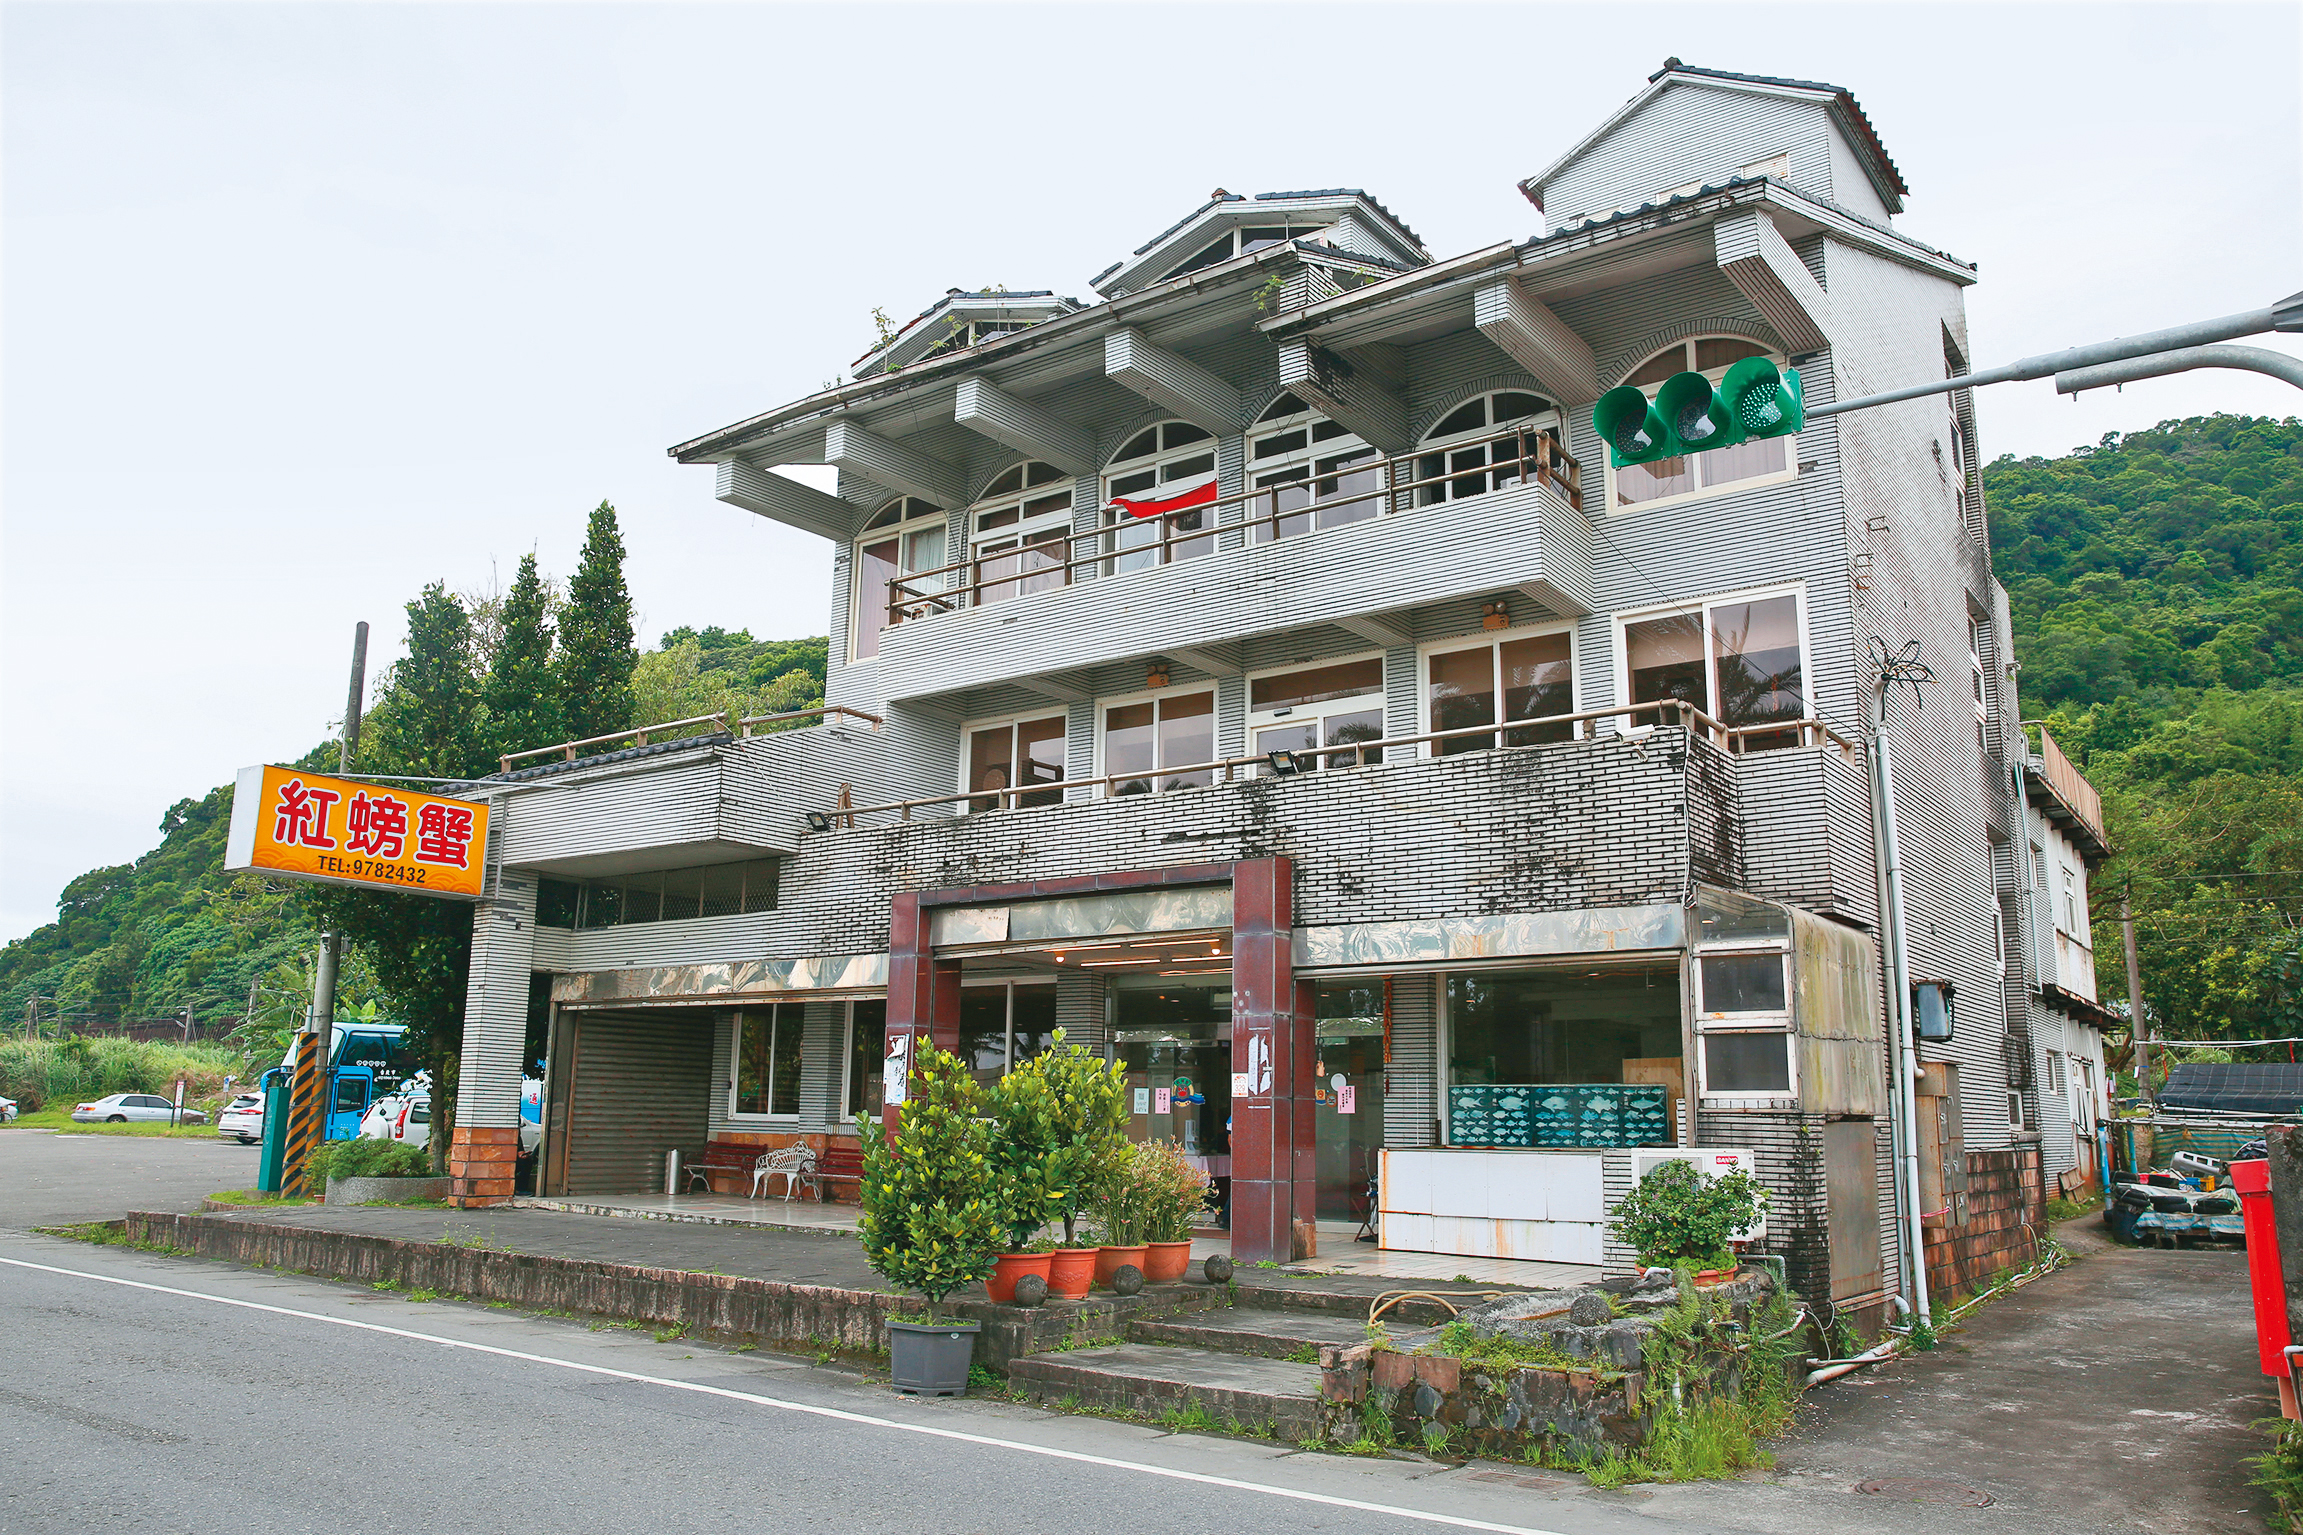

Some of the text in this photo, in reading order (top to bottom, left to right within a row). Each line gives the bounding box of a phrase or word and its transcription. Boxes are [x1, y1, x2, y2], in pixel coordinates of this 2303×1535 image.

[274, 780, 473, 869] 紅螃蟹
[318, 855, 426, 884] TEL:9782432
